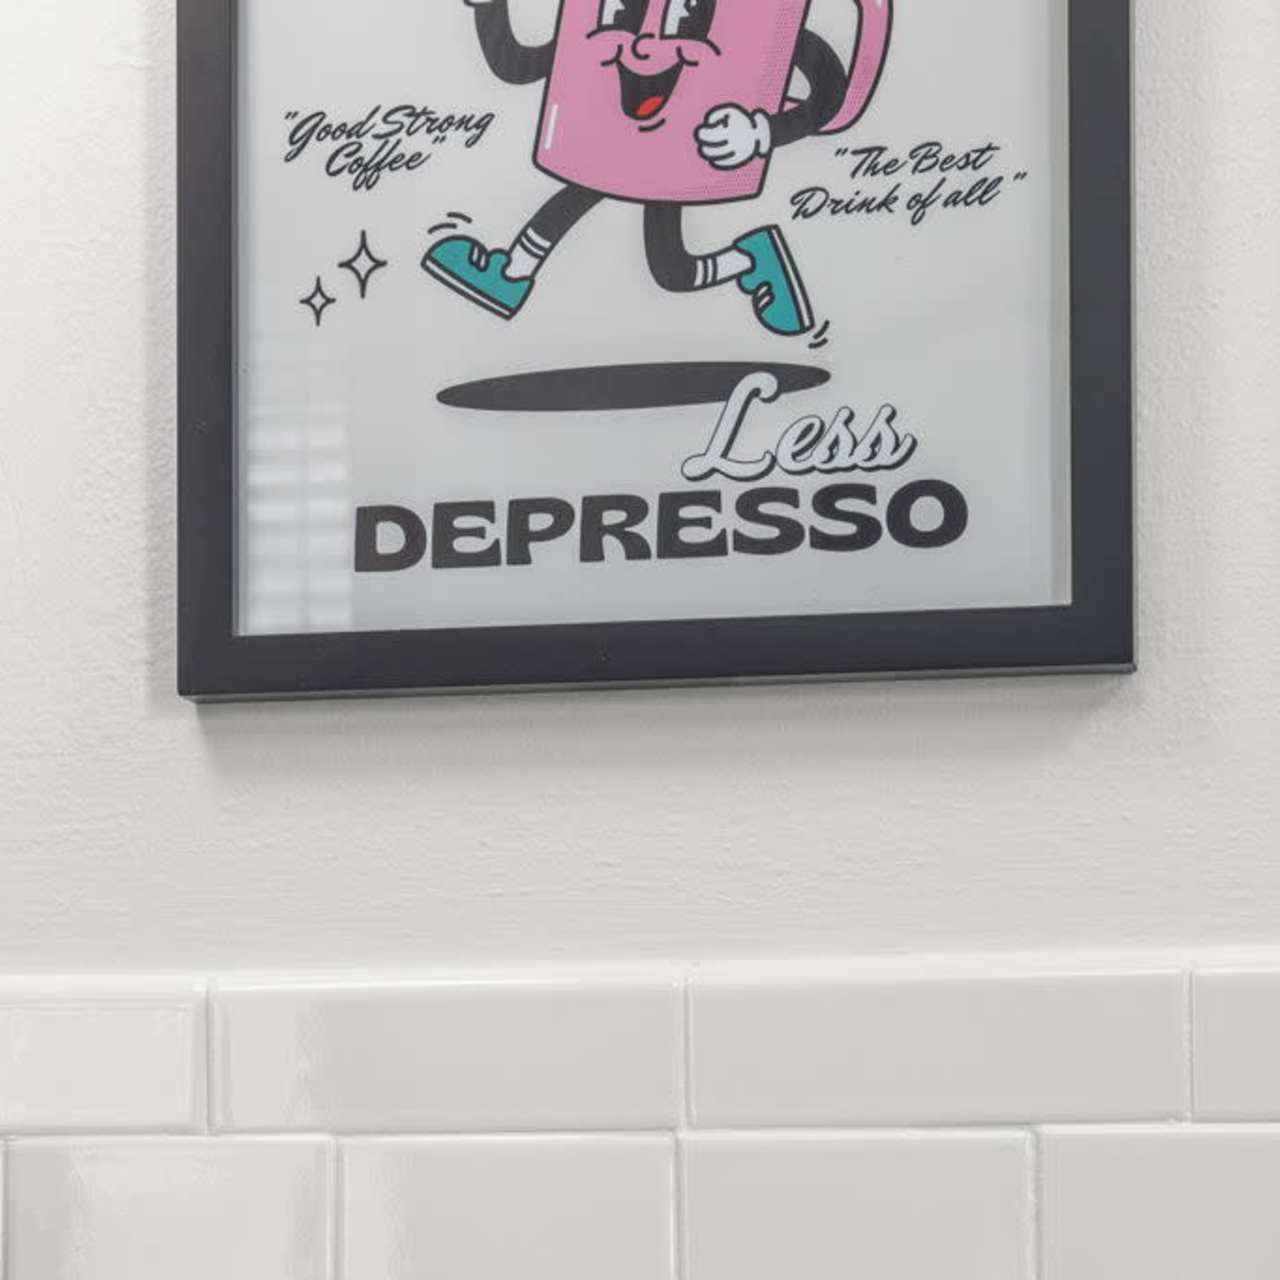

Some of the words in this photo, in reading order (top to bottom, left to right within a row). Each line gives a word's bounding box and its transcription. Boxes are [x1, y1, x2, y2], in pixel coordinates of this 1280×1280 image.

[284, 105, 381, 162] "Good
[371, 104, 495, 149] Strong
[835, 145, 907, 179] "The
[908, 141, 1000, 175] Best
[790, 182, 902, 220] Drink
[906, 176, 947, 226] of
[681, 371, 918, 483] Less
[353, 478, 969, 574] DEPRESSO
